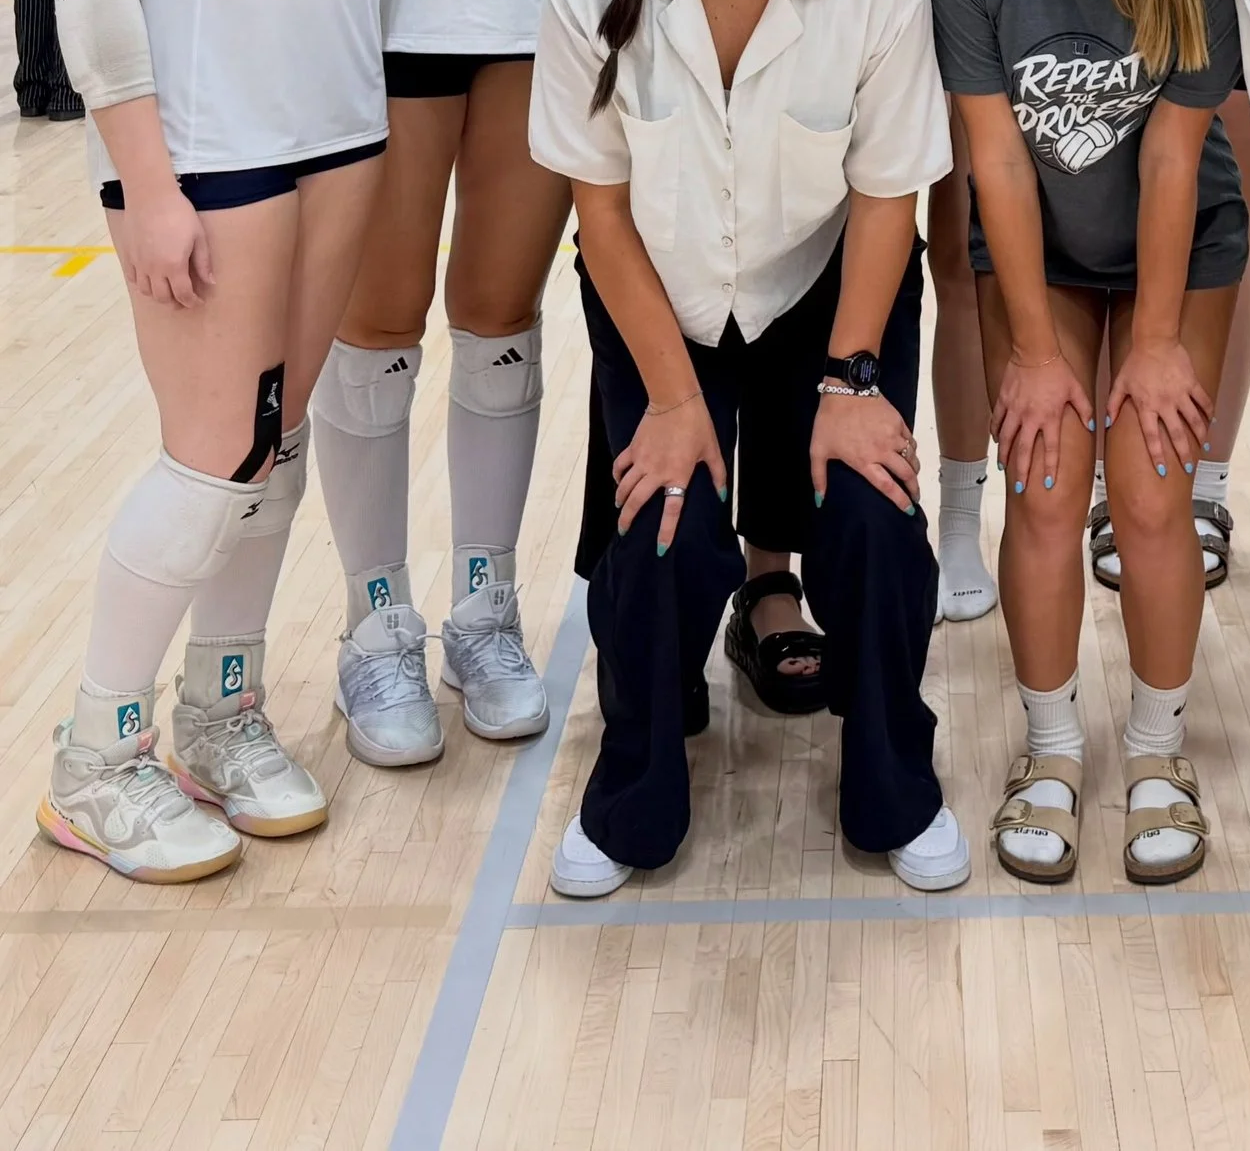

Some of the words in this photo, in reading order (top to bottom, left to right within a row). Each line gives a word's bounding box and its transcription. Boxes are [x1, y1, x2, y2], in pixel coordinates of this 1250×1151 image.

[1013, 52, 1141, 103] REPEAT
[1061, 92, 1099, 105] THE
[1013, 85, 1161, 144] PROCESS
